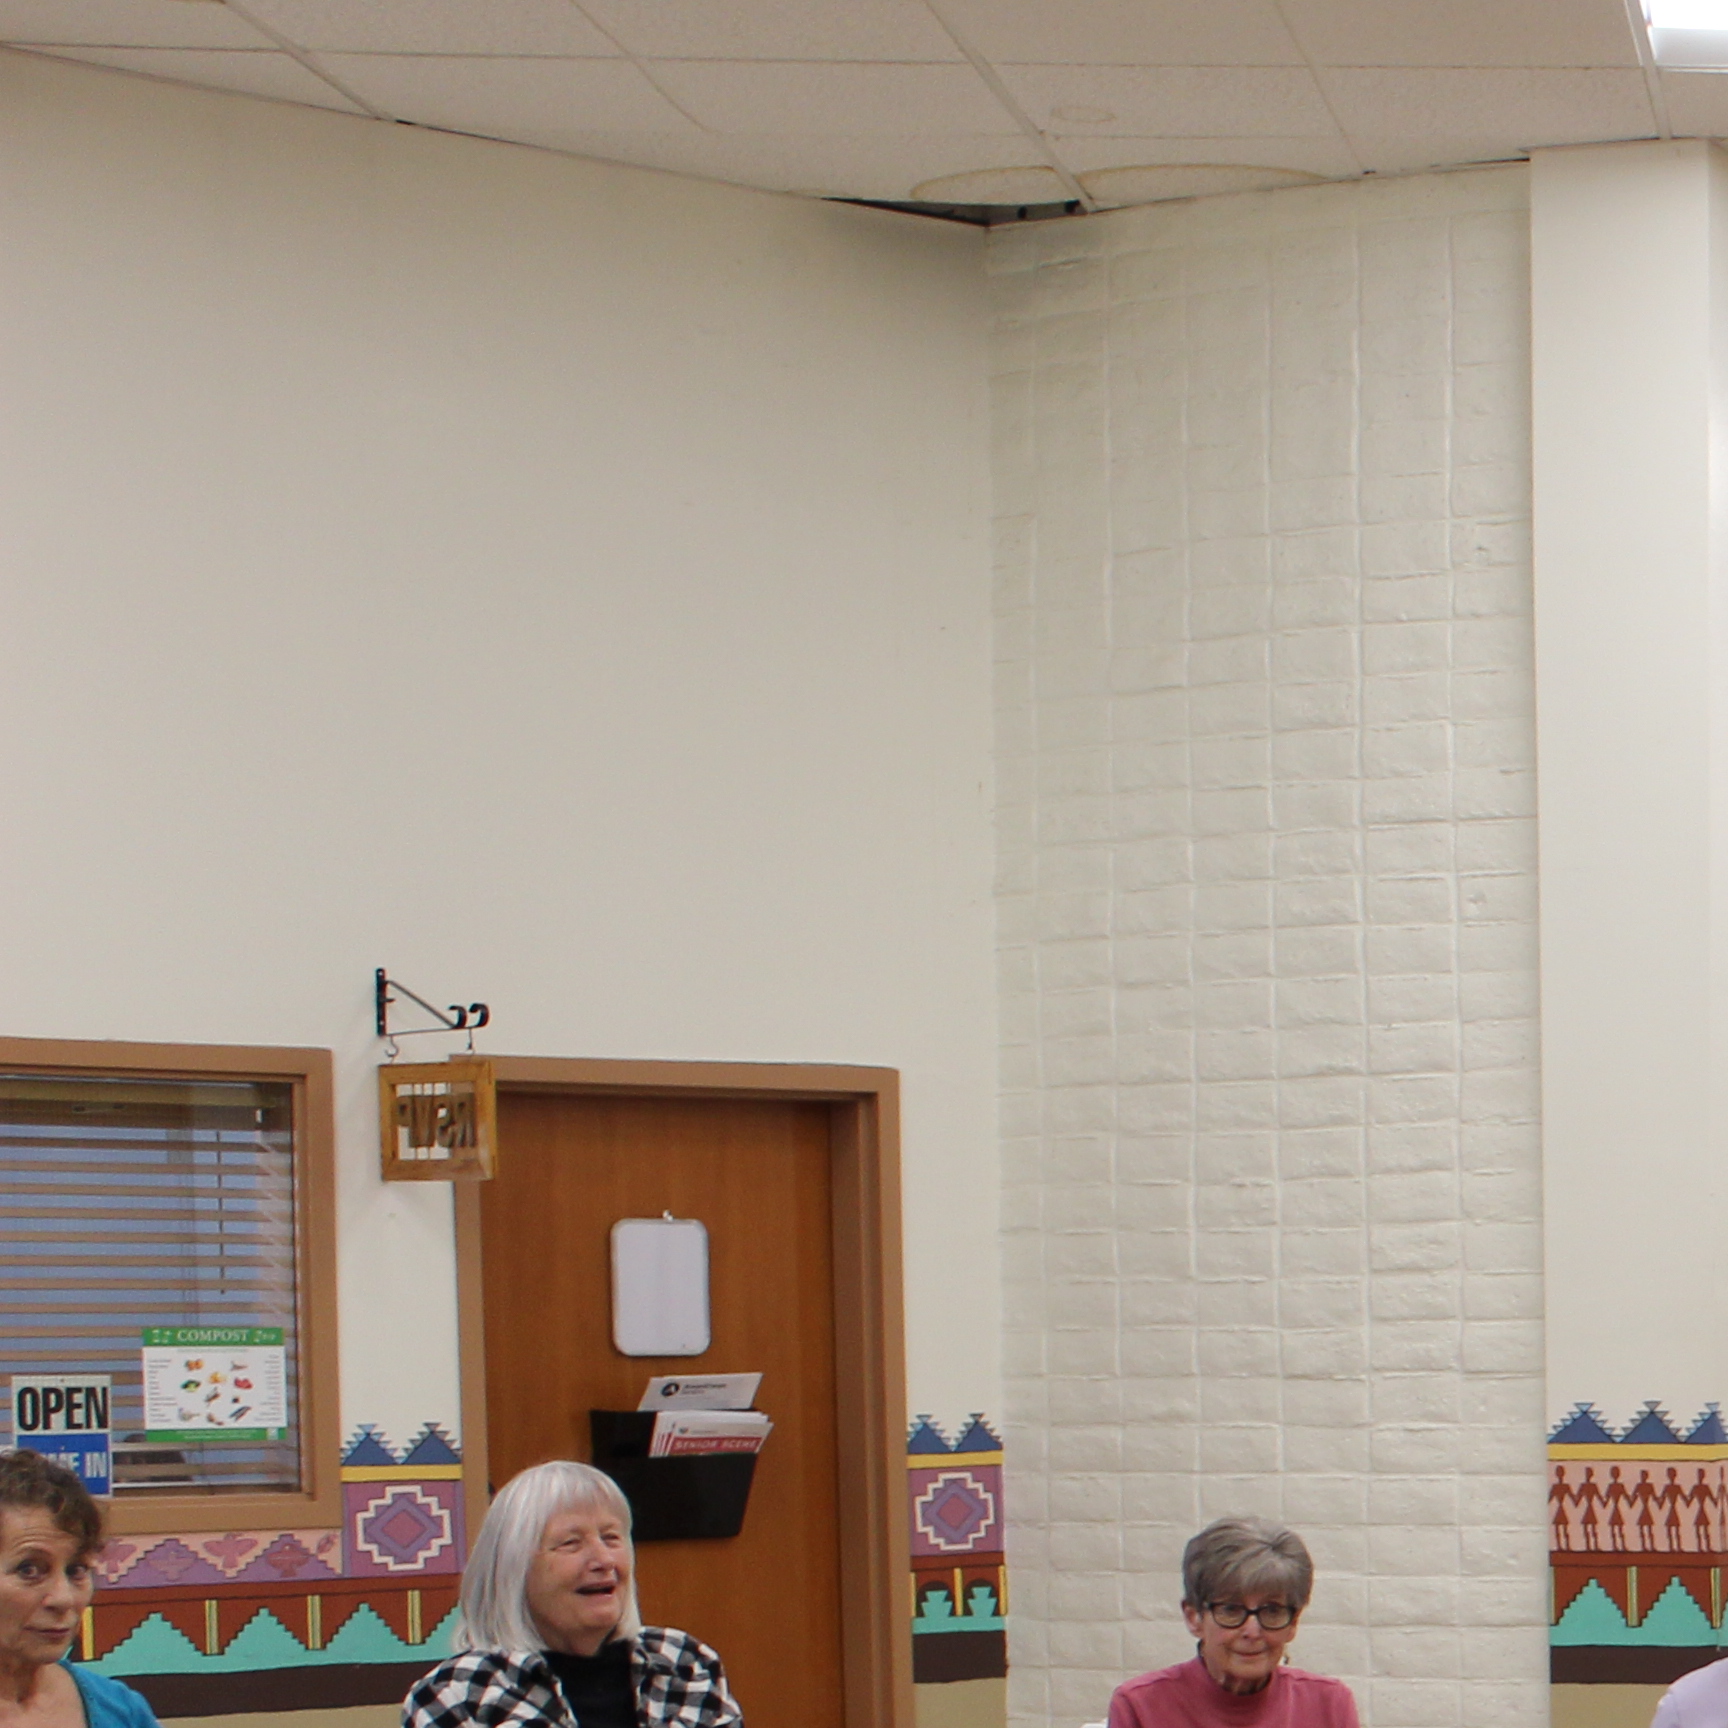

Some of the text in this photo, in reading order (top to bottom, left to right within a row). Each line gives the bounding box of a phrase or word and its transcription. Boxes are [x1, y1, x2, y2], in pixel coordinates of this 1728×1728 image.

[177, 1329, 248, 1342] COMPOST
[17, 1387, 108, 1431] OPEN
[84, 1452, 107, 1478] IN
